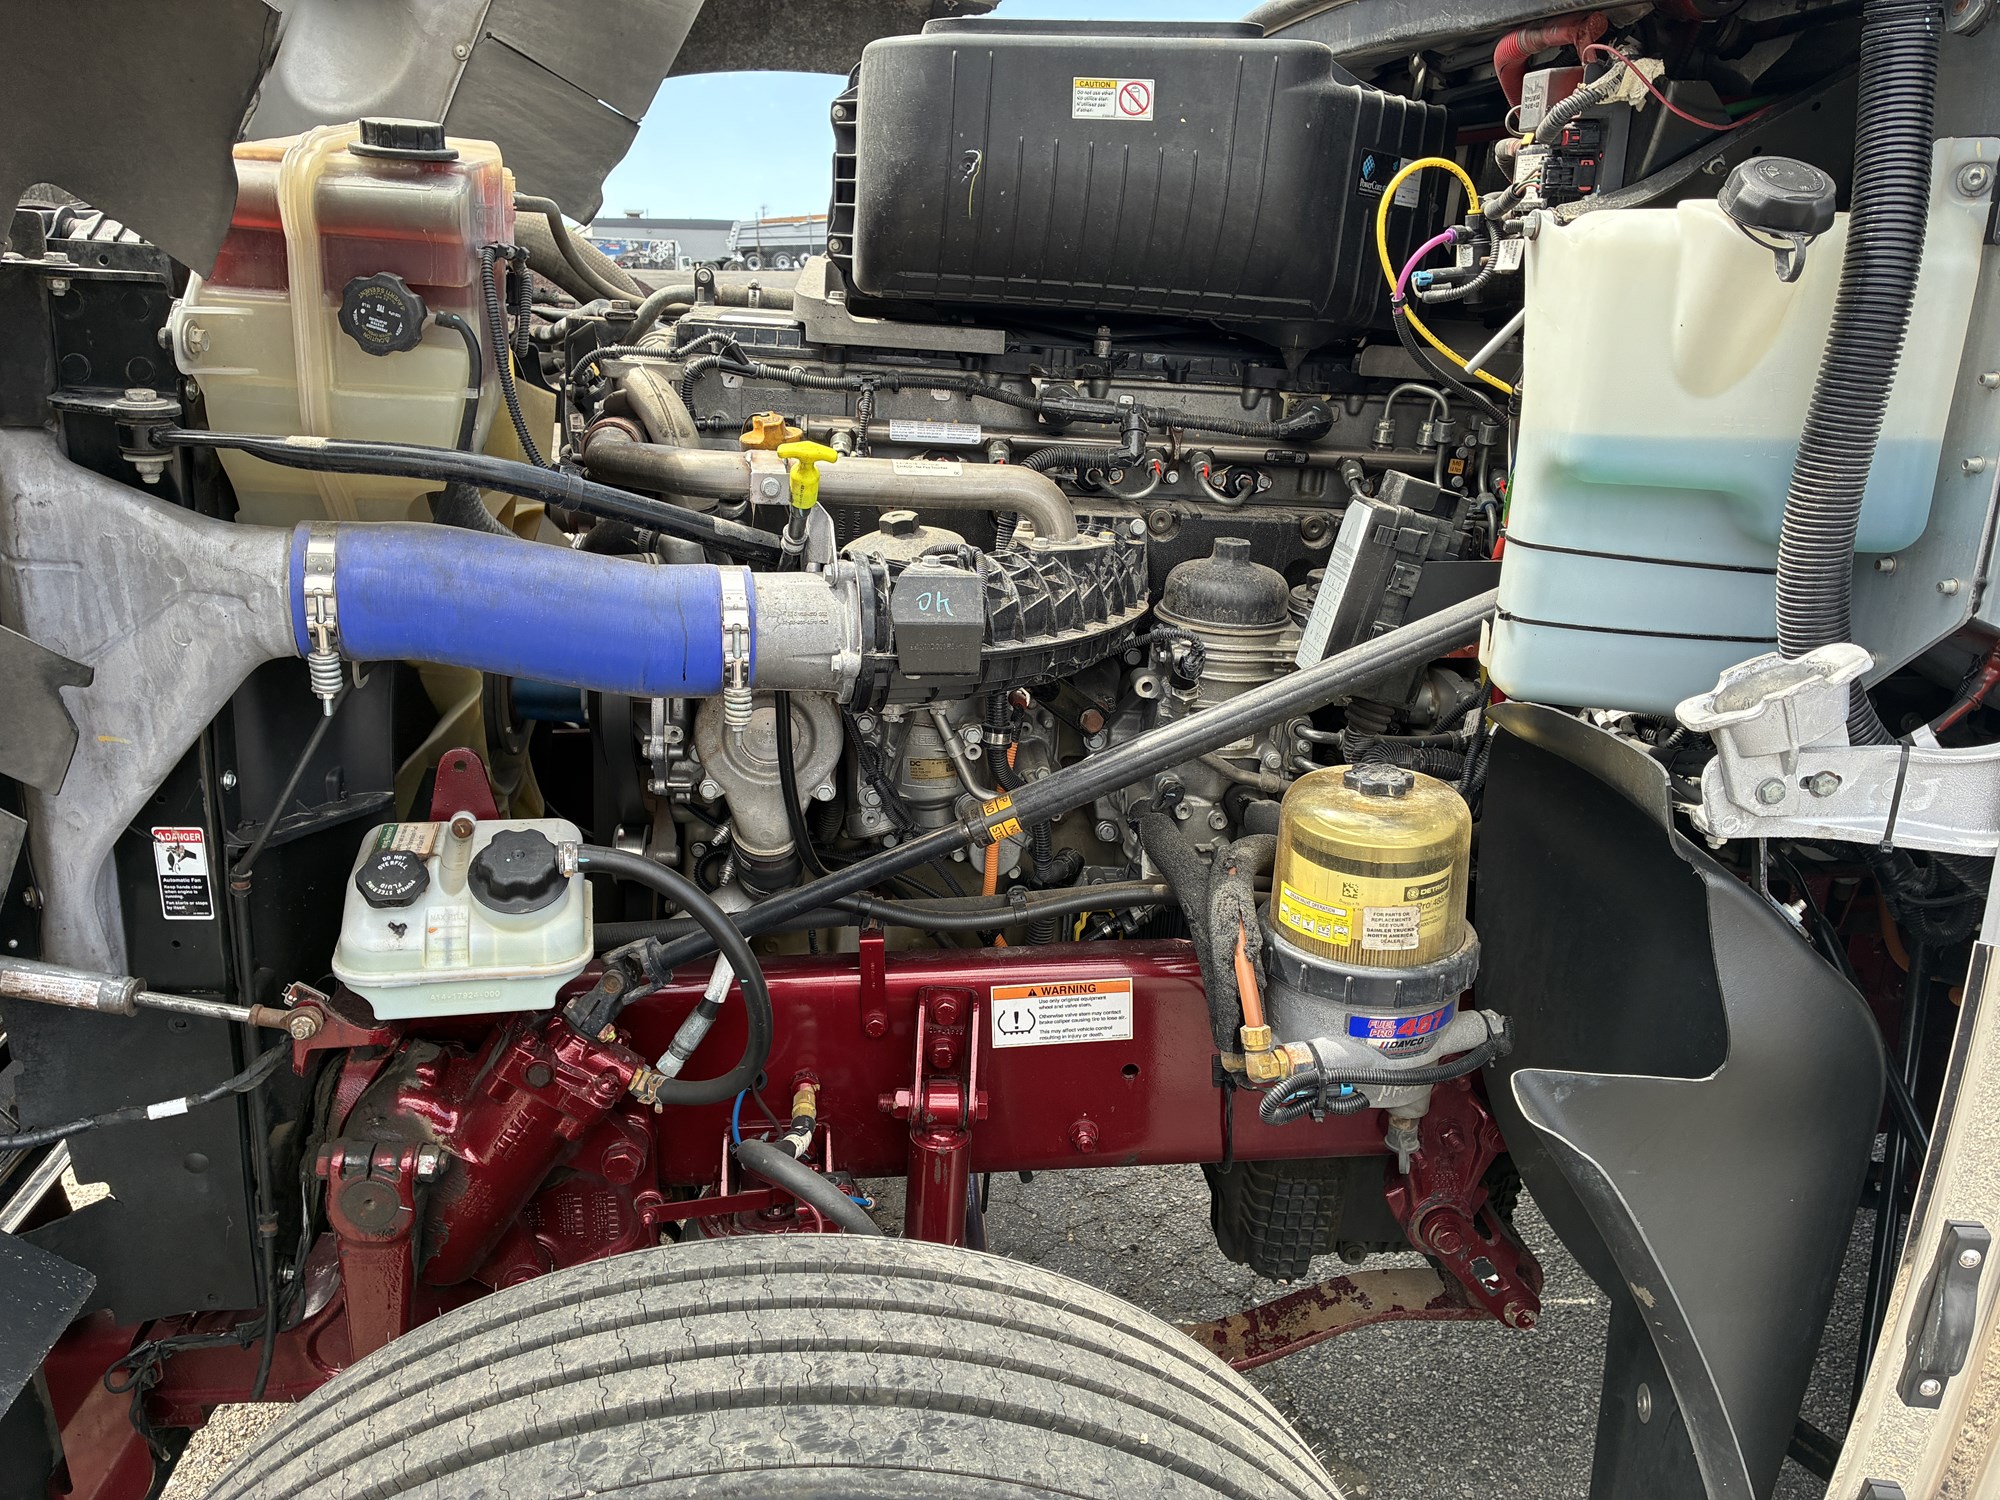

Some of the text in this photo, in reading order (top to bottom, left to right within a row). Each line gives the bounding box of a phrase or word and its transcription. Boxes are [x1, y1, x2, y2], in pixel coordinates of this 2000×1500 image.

[165, 833, 202, 841] DANGER
[377, 860, 408, 871] OVERFILL
[366, 880, 416, 895] POWER STEERING
[1041, 984, 1096, 996] WARNING
[1368, 1010, 1444, 1037] FUEL 487
[1370, 1029, 1395, 1037] PRO
[1389, 1037, 1425, 1049] DAVCO
